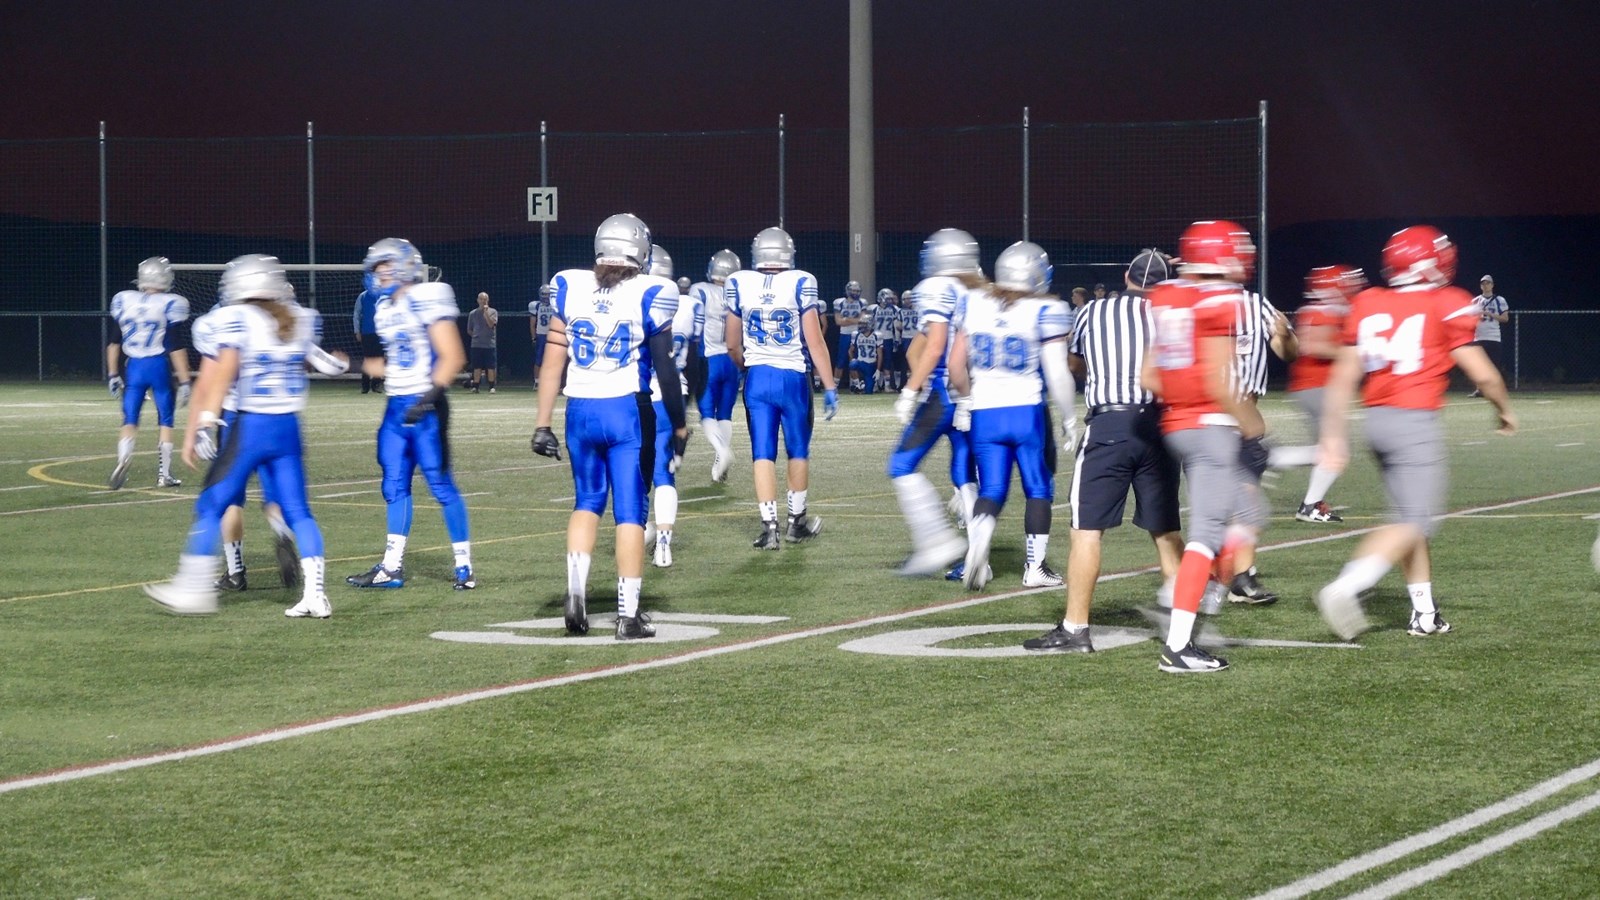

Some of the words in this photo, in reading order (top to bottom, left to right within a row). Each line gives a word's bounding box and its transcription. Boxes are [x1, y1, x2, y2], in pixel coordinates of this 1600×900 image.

[532, 193, 553, 215] F1
[121, 319, 159, 348] 27
[745, 308, 796, 346] 43
[876, 317, 893, 331] 72
[568, 317, 634, 370] 64
[1357, 312, 1426, 376] 64
